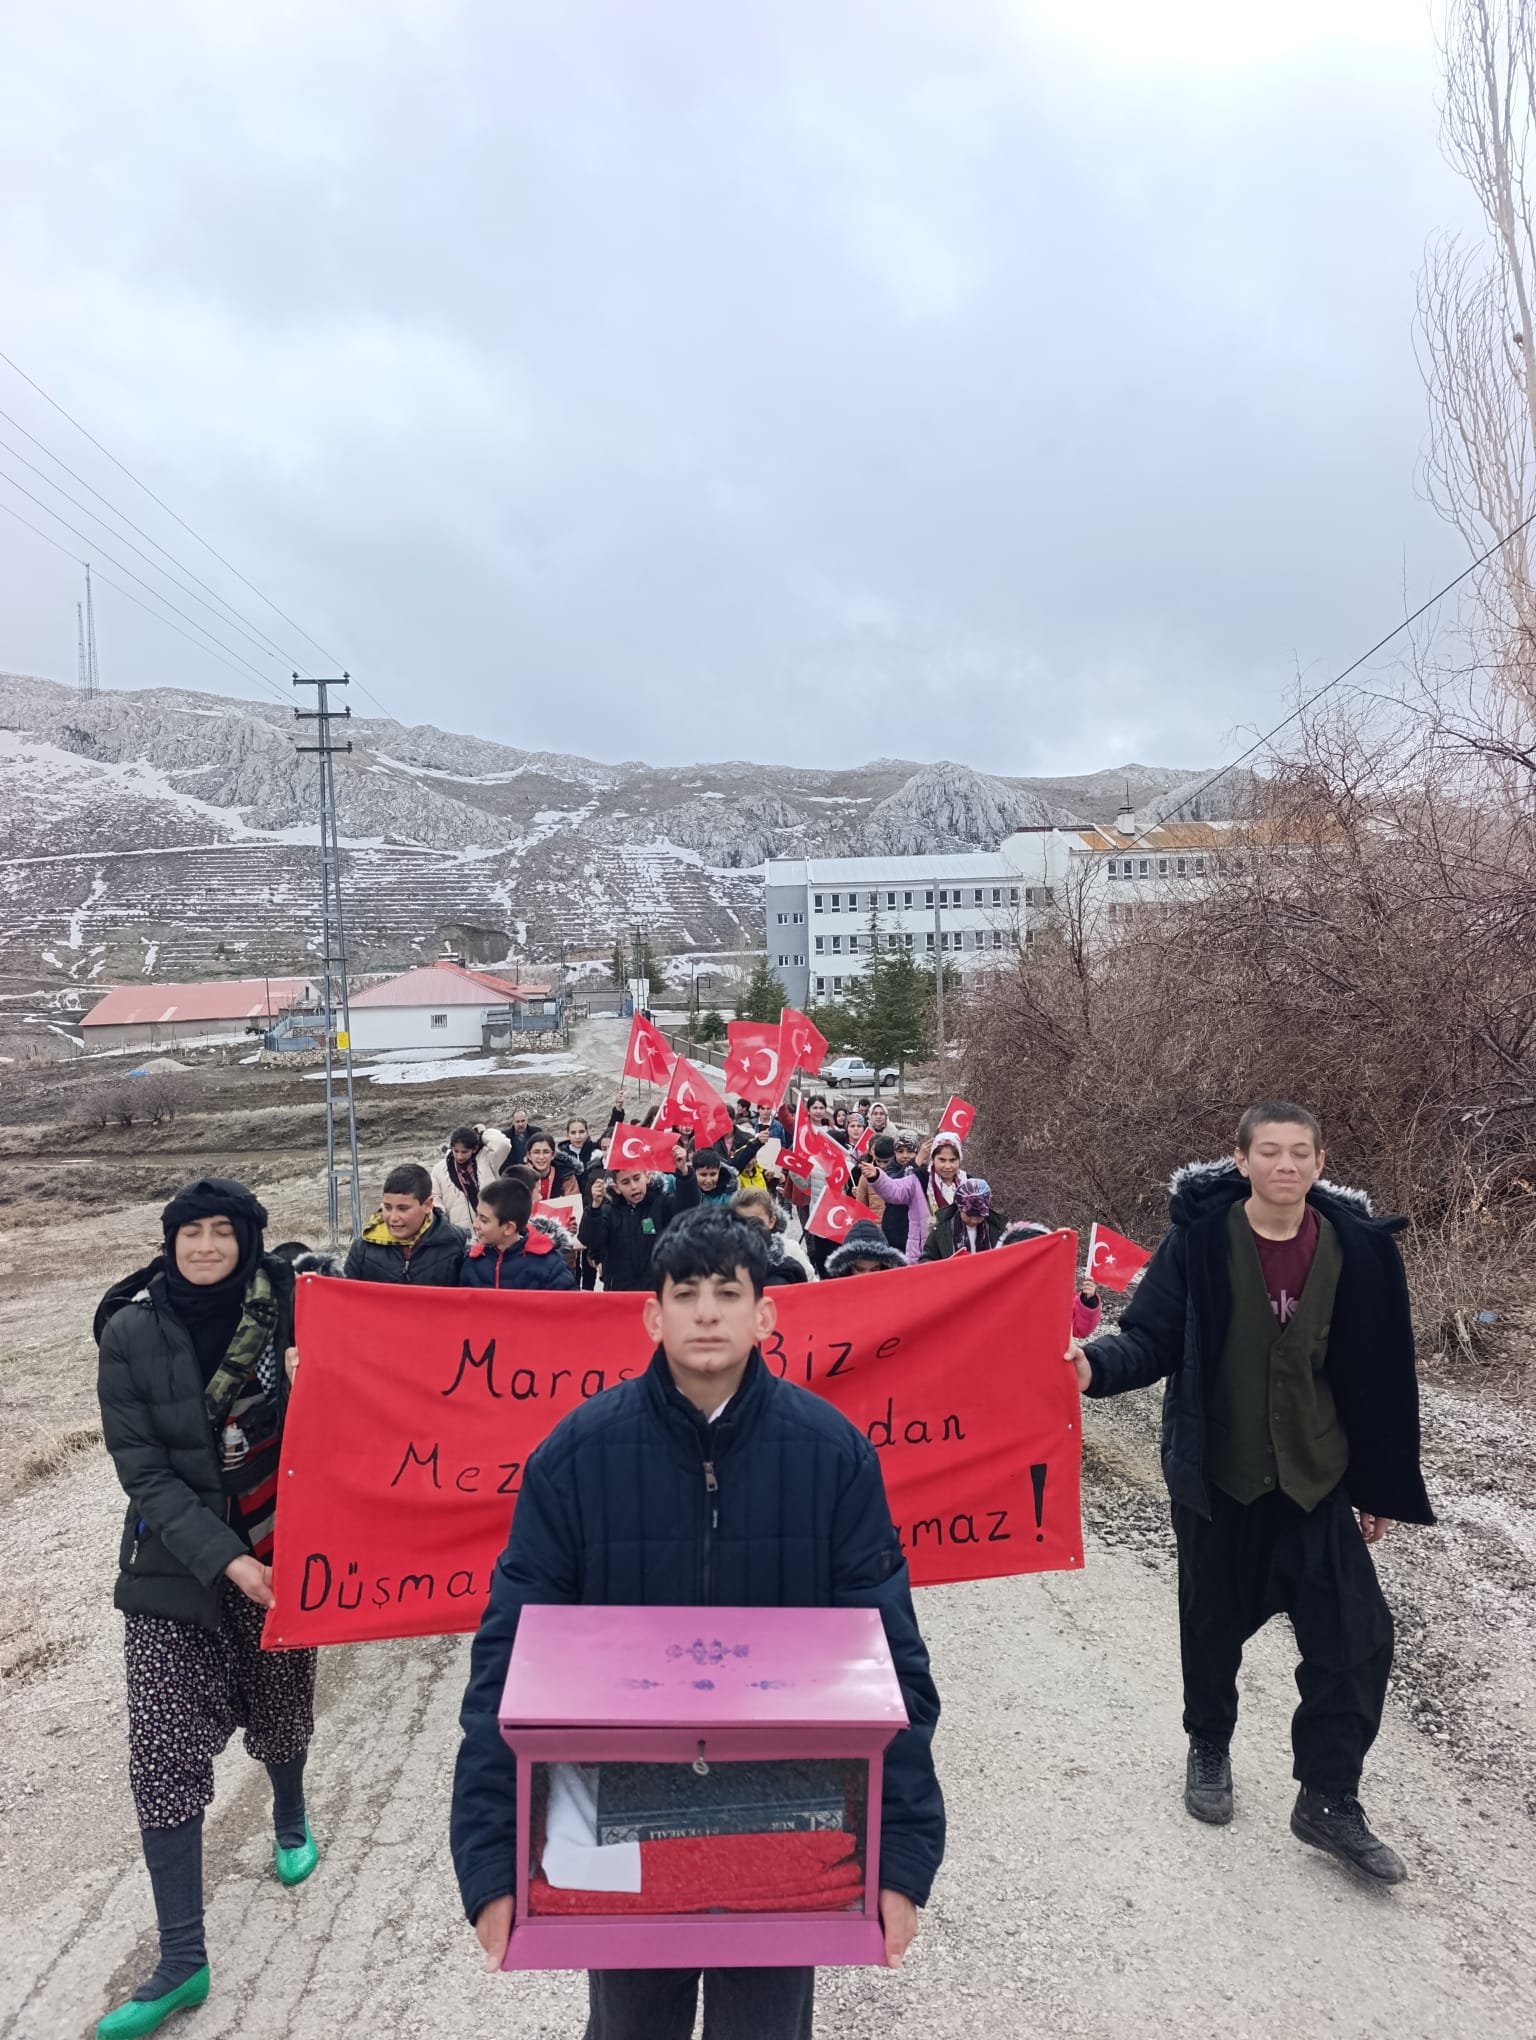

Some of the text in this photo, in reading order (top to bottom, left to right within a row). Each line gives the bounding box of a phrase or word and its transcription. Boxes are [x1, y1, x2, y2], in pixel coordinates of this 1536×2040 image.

[758, 1330, 900, 1382] Bize
[300, 1463, 1047, 1611] Düşma maz!
